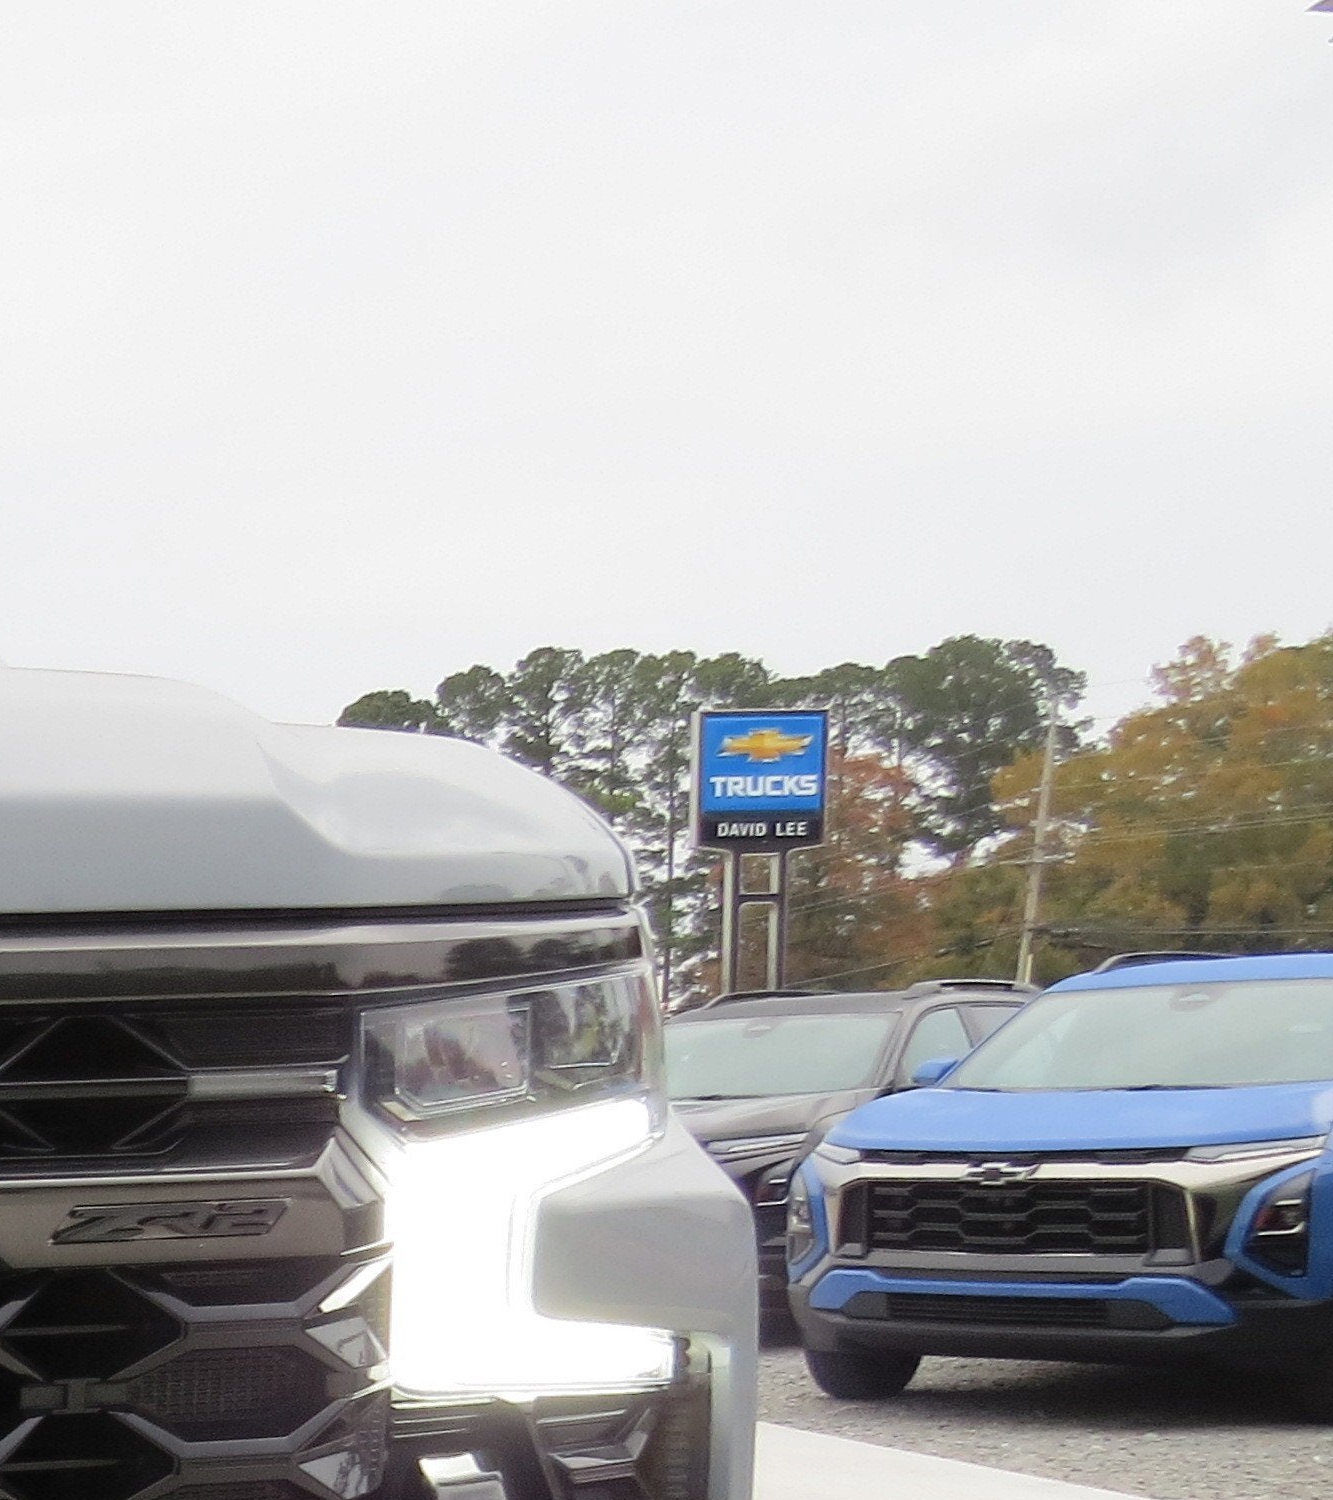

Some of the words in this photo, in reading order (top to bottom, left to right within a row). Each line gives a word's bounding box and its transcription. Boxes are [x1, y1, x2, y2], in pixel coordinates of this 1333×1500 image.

[709, 774, 819, 797] TRUCKS
[716, 821, 767, 837] DAVID
[774, 821, 808, 837] LEE
